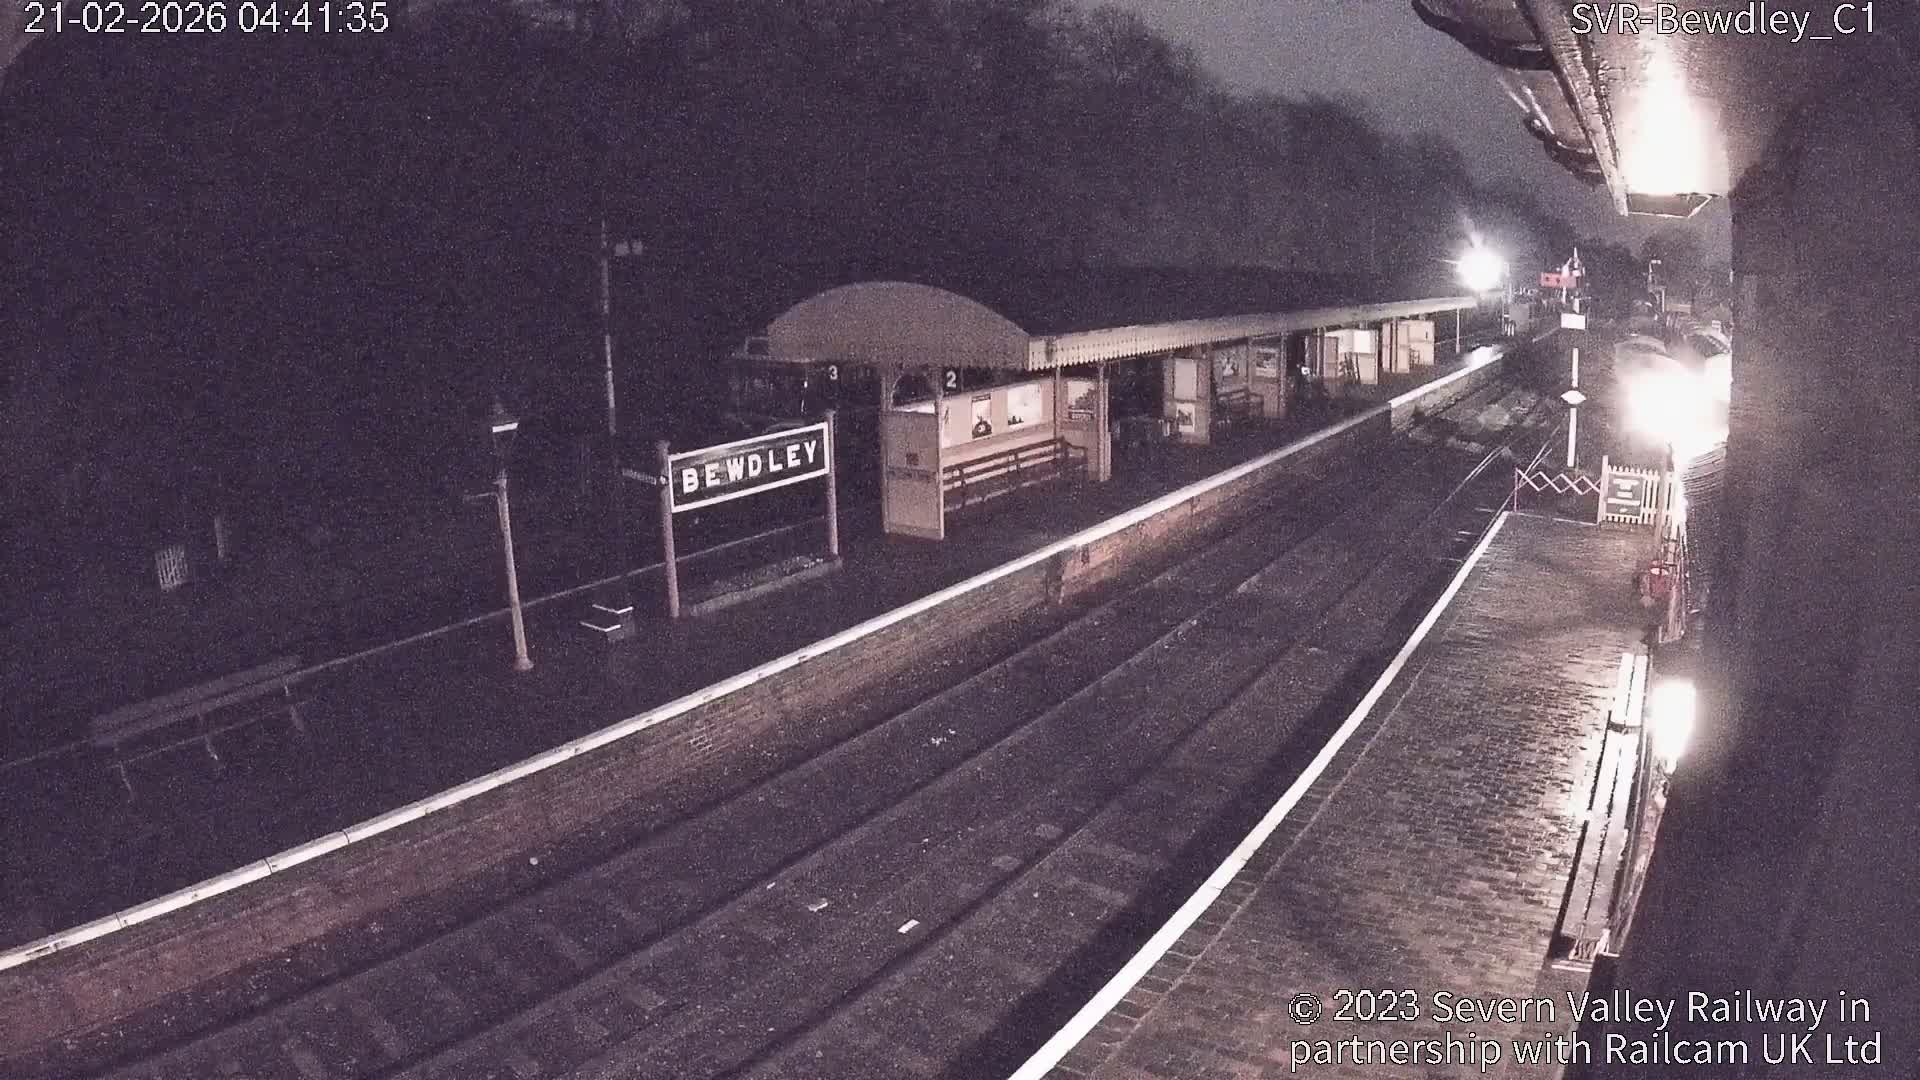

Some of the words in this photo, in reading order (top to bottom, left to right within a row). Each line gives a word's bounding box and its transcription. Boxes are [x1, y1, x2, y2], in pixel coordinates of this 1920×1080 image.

[829, 365, 839, 380] 3
[946, 371, 957, 388] 2
[681, 440, 818, 494] BEWDLEY
